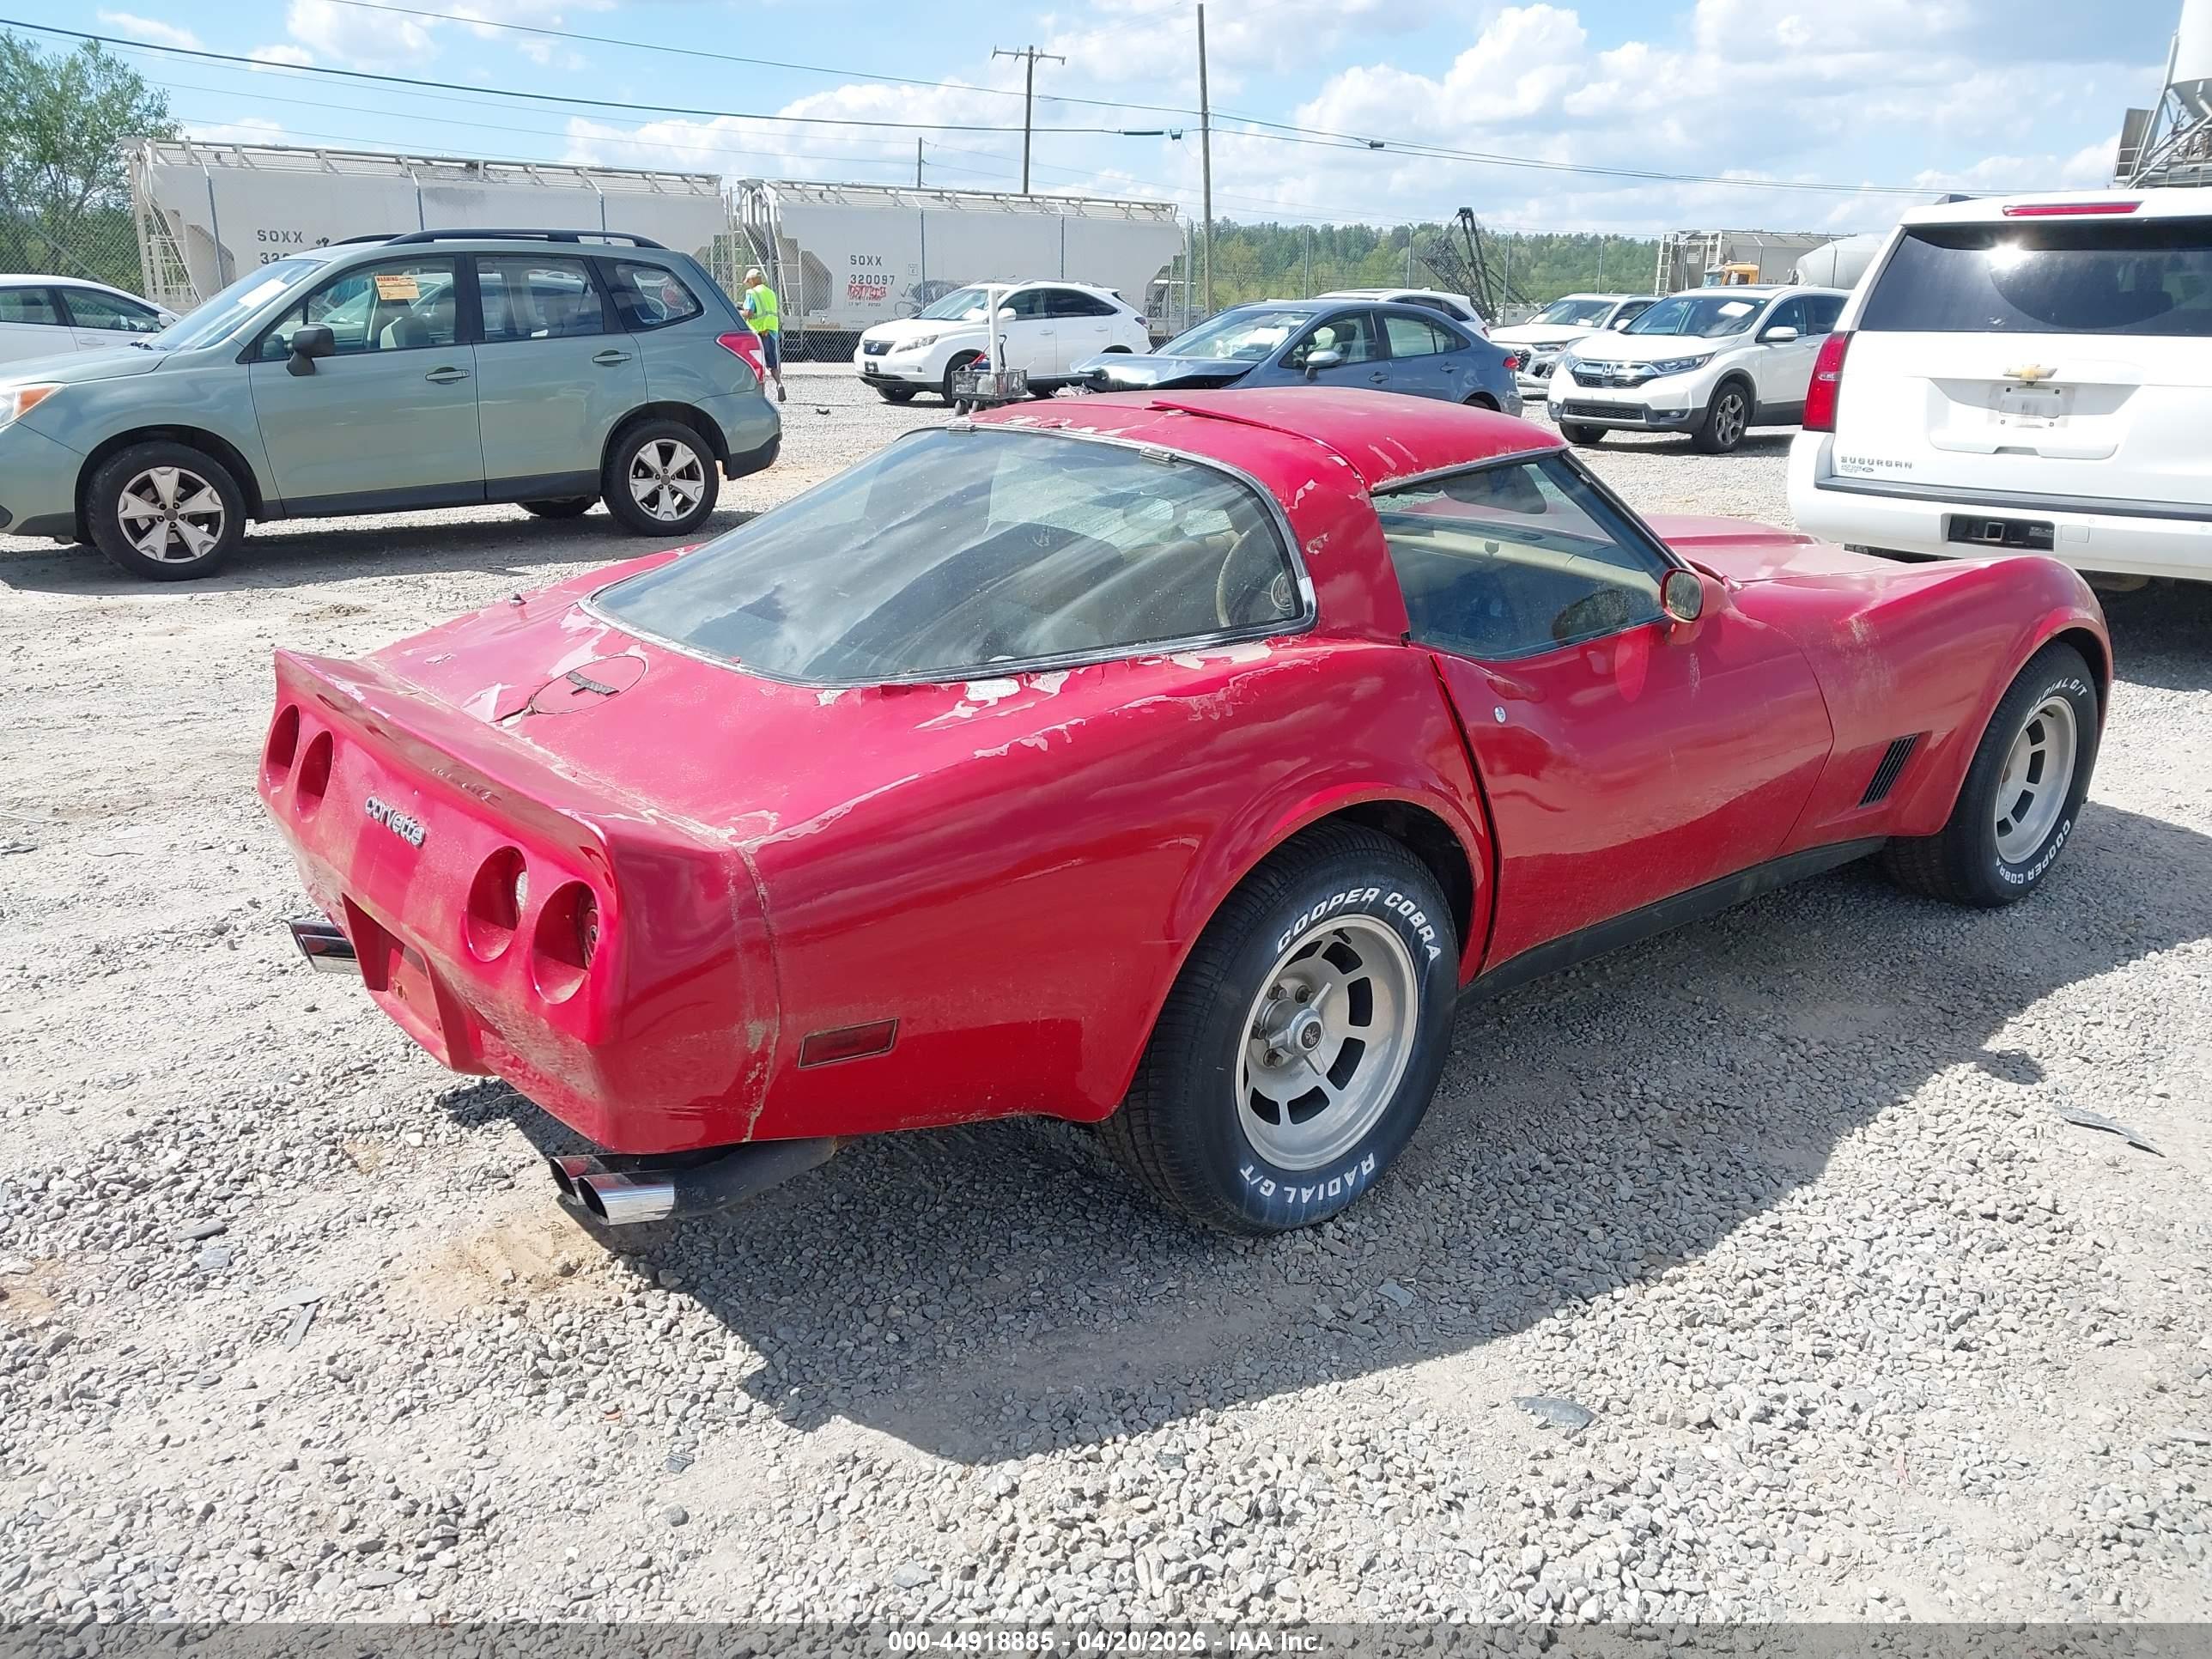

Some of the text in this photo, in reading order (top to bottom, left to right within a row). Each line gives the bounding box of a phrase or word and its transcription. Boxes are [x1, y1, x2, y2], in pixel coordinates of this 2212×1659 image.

[257, 228, 303, 244] SOXX
[850, 254, 882, 266] SOXX
[850, 274, 895, 286] 320097
[1840, 456, 1913, 470] SUBURBAN
[1996, 819, 2071, 884] COOPER COBRA
[1276, 886, 1442, 962] COOPER COBRA
[1239, 1152, 1375, 1204] RADIAL G/T
